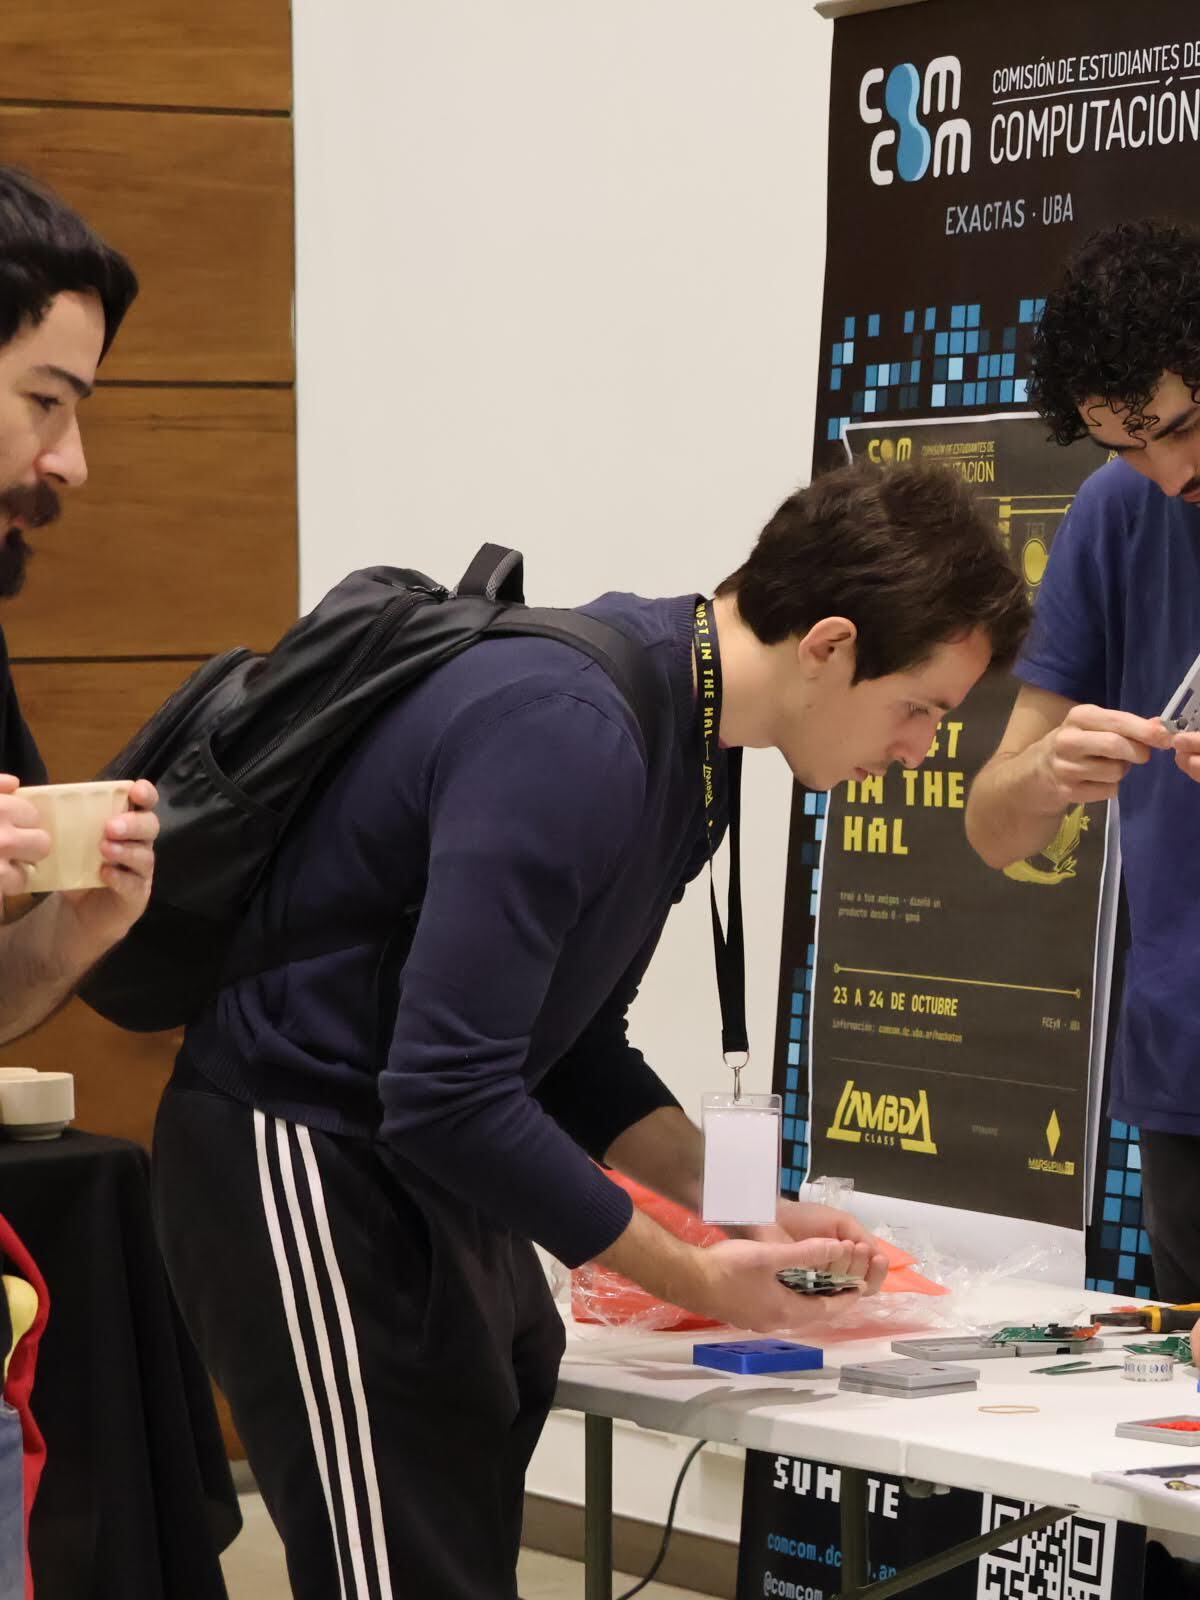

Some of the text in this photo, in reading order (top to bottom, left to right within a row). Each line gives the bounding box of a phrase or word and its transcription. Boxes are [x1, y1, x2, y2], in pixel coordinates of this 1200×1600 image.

[992, 56, 1055, 93] COMISIÓN
[1058, 57, 1075, 84] DE
[1079, 44, 1180, 82] ESTUDIANTES
[990, 76, 1200, 164] COMPUTACIÓN
[945, 199, 1025, 235] EXACTAS
[1042, 193, 1073, 225] UBA
[701, 642, 712, 660] IN
[703, 669, 714, 699] THE
[703, 707, 713, 740] HAL
[903, 770, 965, 809] THE
[843, 815, 909, 855] HAL
[833, 985, 959, 1017] 23 A 24 DE OCTUBRE
[826, 1080, 938, 1155] LAMBDA
[864, 1133, 895, 1148] CLASS
[773, 1456, 900, 1520] SUMTE
